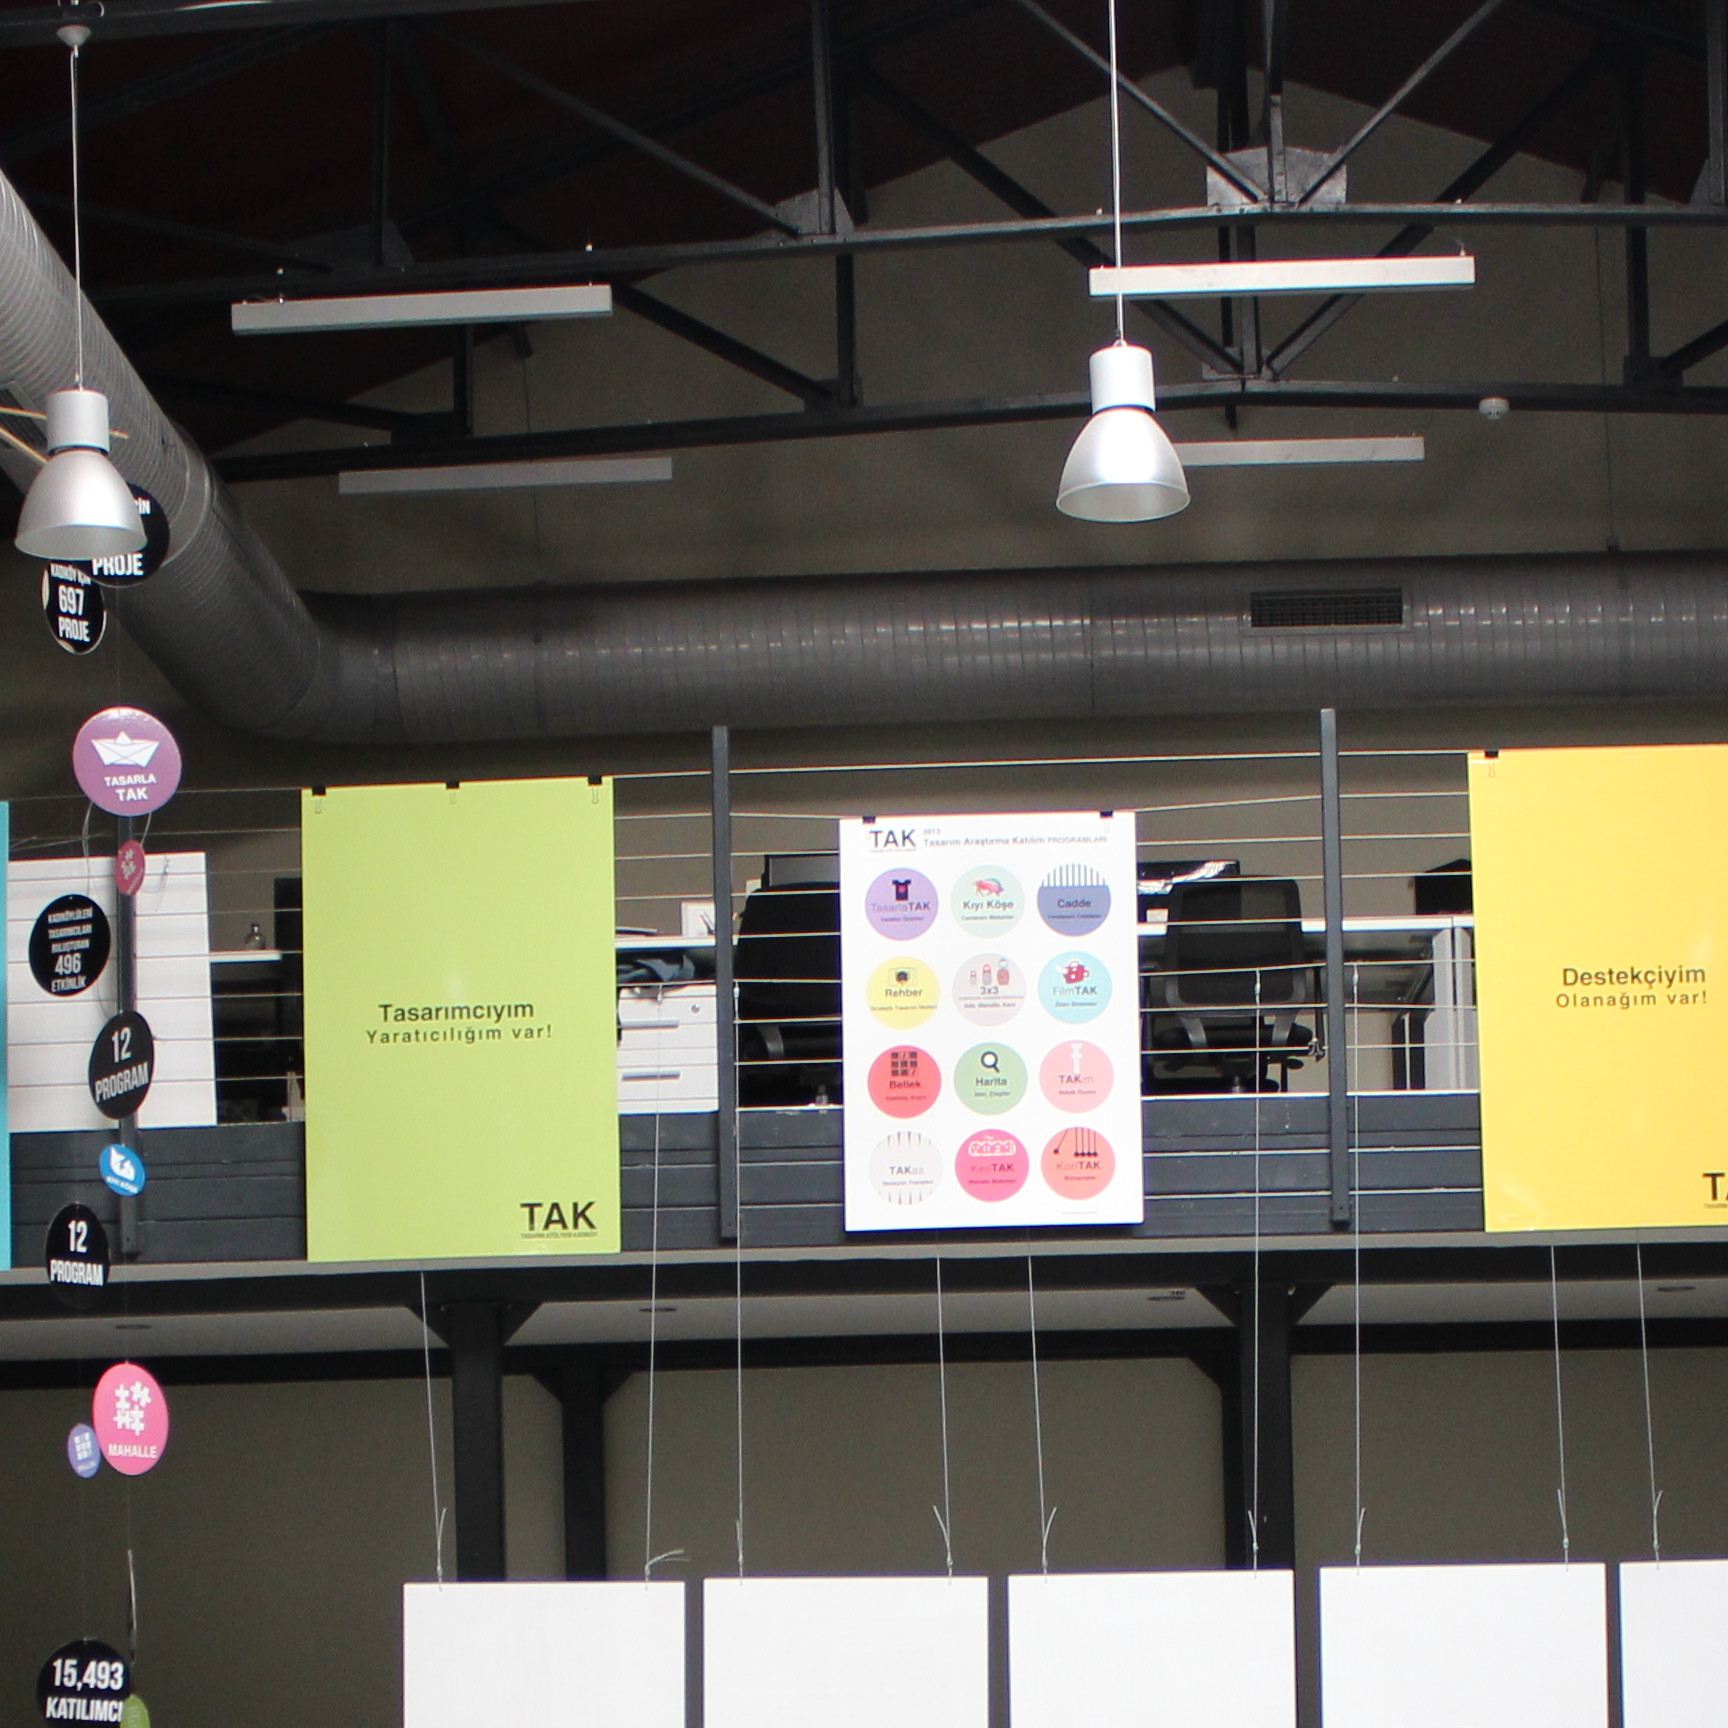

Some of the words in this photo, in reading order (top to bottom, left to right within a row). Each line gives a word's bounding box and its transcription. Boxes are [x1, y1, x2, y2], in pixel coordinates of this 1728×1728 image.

[91, 553, 145, 577] PROJE
[58, 584, 84, 616] 697
[58, 616, 91, 642] PROJE
[103, 773, 158, 787] TASARLA
[115, 787, 149, 802] TAK
[870, 828, 917, 848] TAK
[923, 838, 962, 847] Tasarım
[963, 836, 1010, 848] Araştırma
[871, 901, 931, 912] TasarlaTAK
[986, 899, 1014, 912] Köşe
[1057, 898, 1092, 908] Cadde
[54, 953, 82, 976] 496
[1562, 965, 1708, 989] Destekçiyim
[885, 988, 924, 998] Rehber
[980, 986, 999, 995] 3x3
[1052, 986, 1098, 996] FilmTAK
[1556, 991, 1658, 1011] Olanağım
[1667, 989, 1709, 1006] var!
[379, 1003, 534, 1023] Tasarımcıyım
[366, 1027, 502, 1044] Yaratıcılığım
[512, 1024, 553, 1040] var!
[111, 1027, 132, 1064] 12
[95, 1061, 150, 1103] PROGRAM
[889, 1080, 922, 1090] Bellek
[975, 1076, 1008, 1087] Harita
[889, 1165, 925, 1176] TAKas
[972, 1163, 1015, 1173] KesTAK
[1056, 1161, 1101, 1171] KonTAK
[520, 1201, 598, 1232] TAK
[68, 1220, 88, 1253] 12
[50, 1258, 105, 1287] PROGRAM
[108, 1444, 158, 1459] MAHALLE
[52, 1658, 124, 1691] 15,493
[46, 1696, 123, 1723] KATILIMCI
